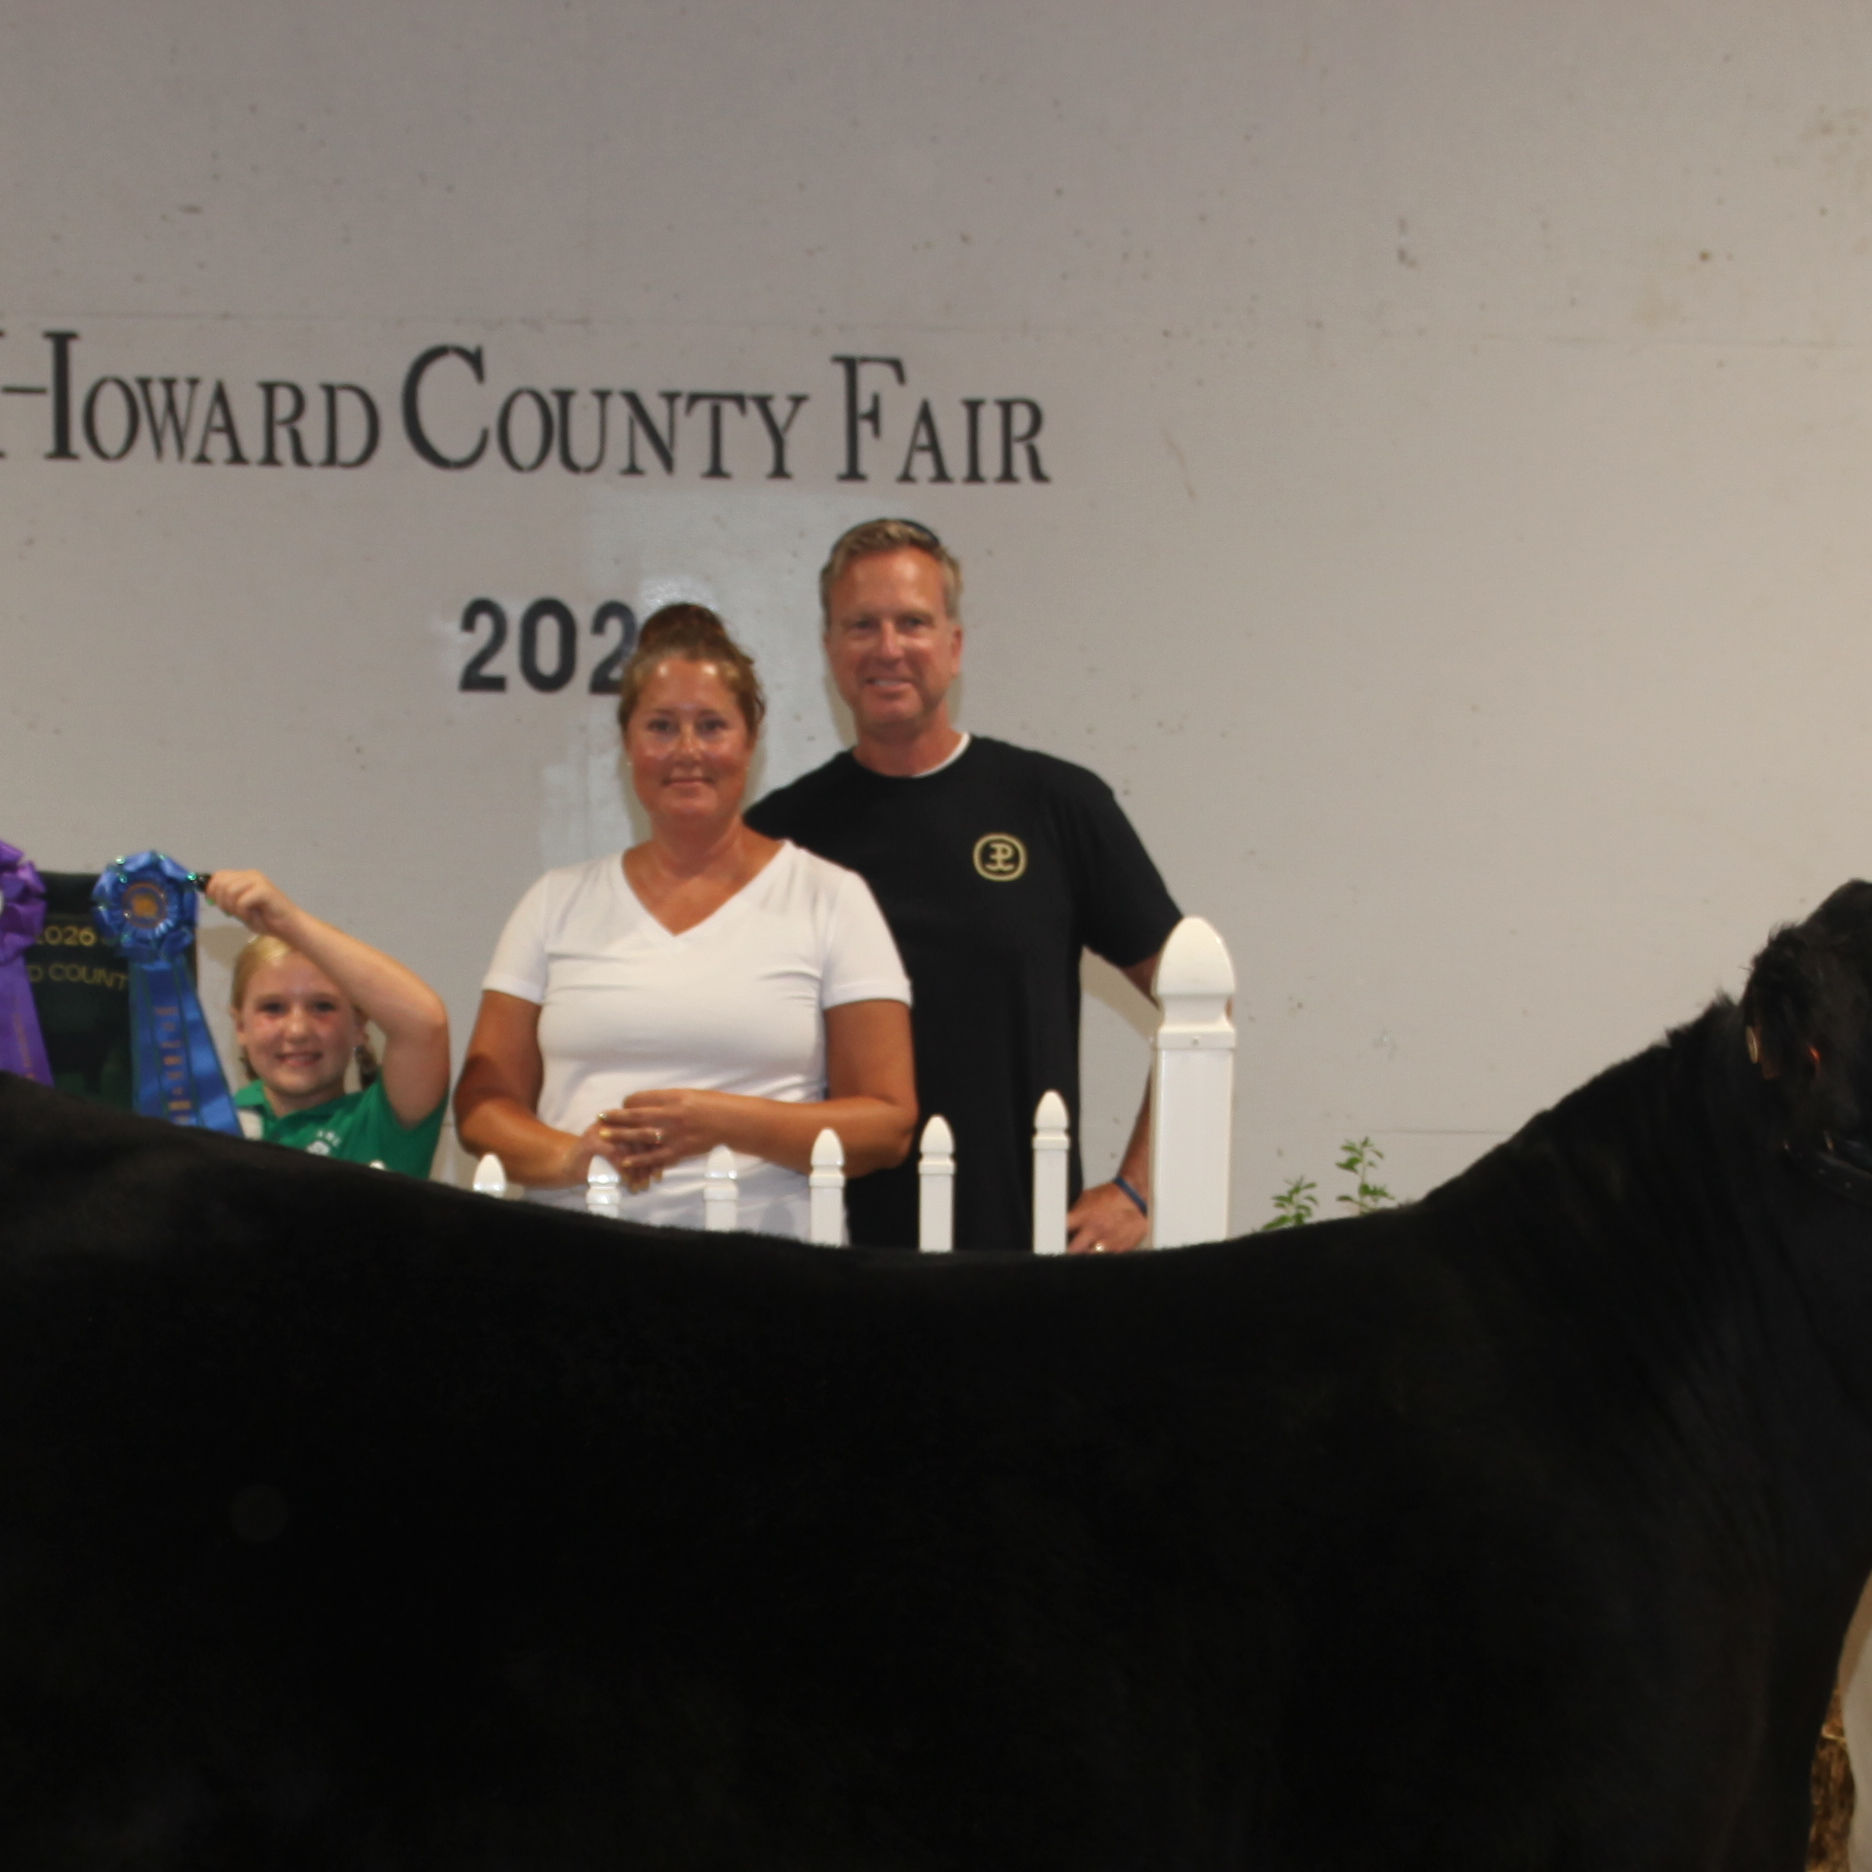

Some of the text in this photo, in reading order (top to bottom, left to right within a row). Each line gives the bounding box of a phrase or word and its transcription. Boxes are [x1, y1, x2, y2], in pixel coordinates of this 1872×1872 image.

[458, 596, 639, 695] 202
[36, 926, 97, 947] 026
[48, 963, 128, 990] COUNT
